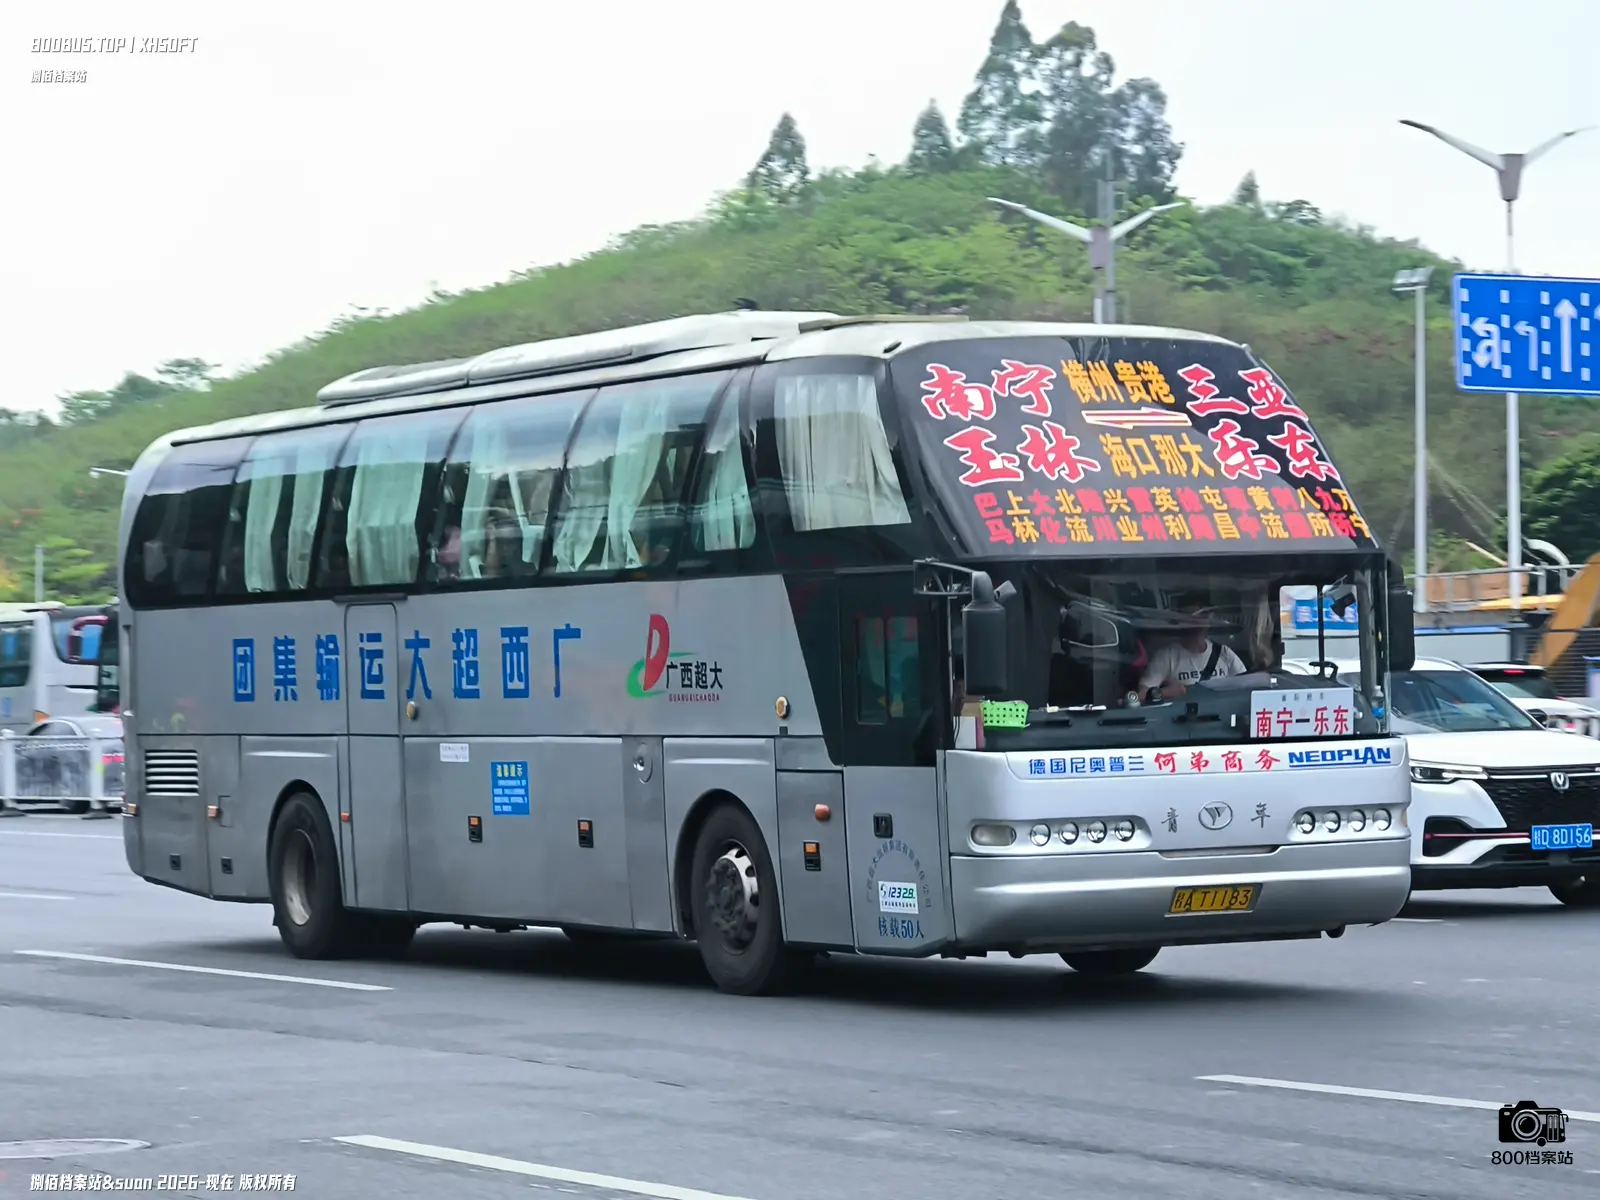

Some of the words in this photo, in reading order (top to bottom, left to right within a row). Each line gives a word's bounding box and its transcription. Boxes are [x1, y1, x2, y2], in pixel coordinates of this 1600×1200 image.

[920, 359, 1057, 421] 南宁
[1177, 363, 1308, 421] 三亚
[943, 420, 1101, 486] 玉林
[1208, 418, 1341, 482] 乐东
[666, 661, 723, 690] 广西超大
[1154, 749, 1280, 774] 何弟商务
[1288, 746, 1391, 768] NEOPLAN
[878, 916, 924, 939] 核载50人
